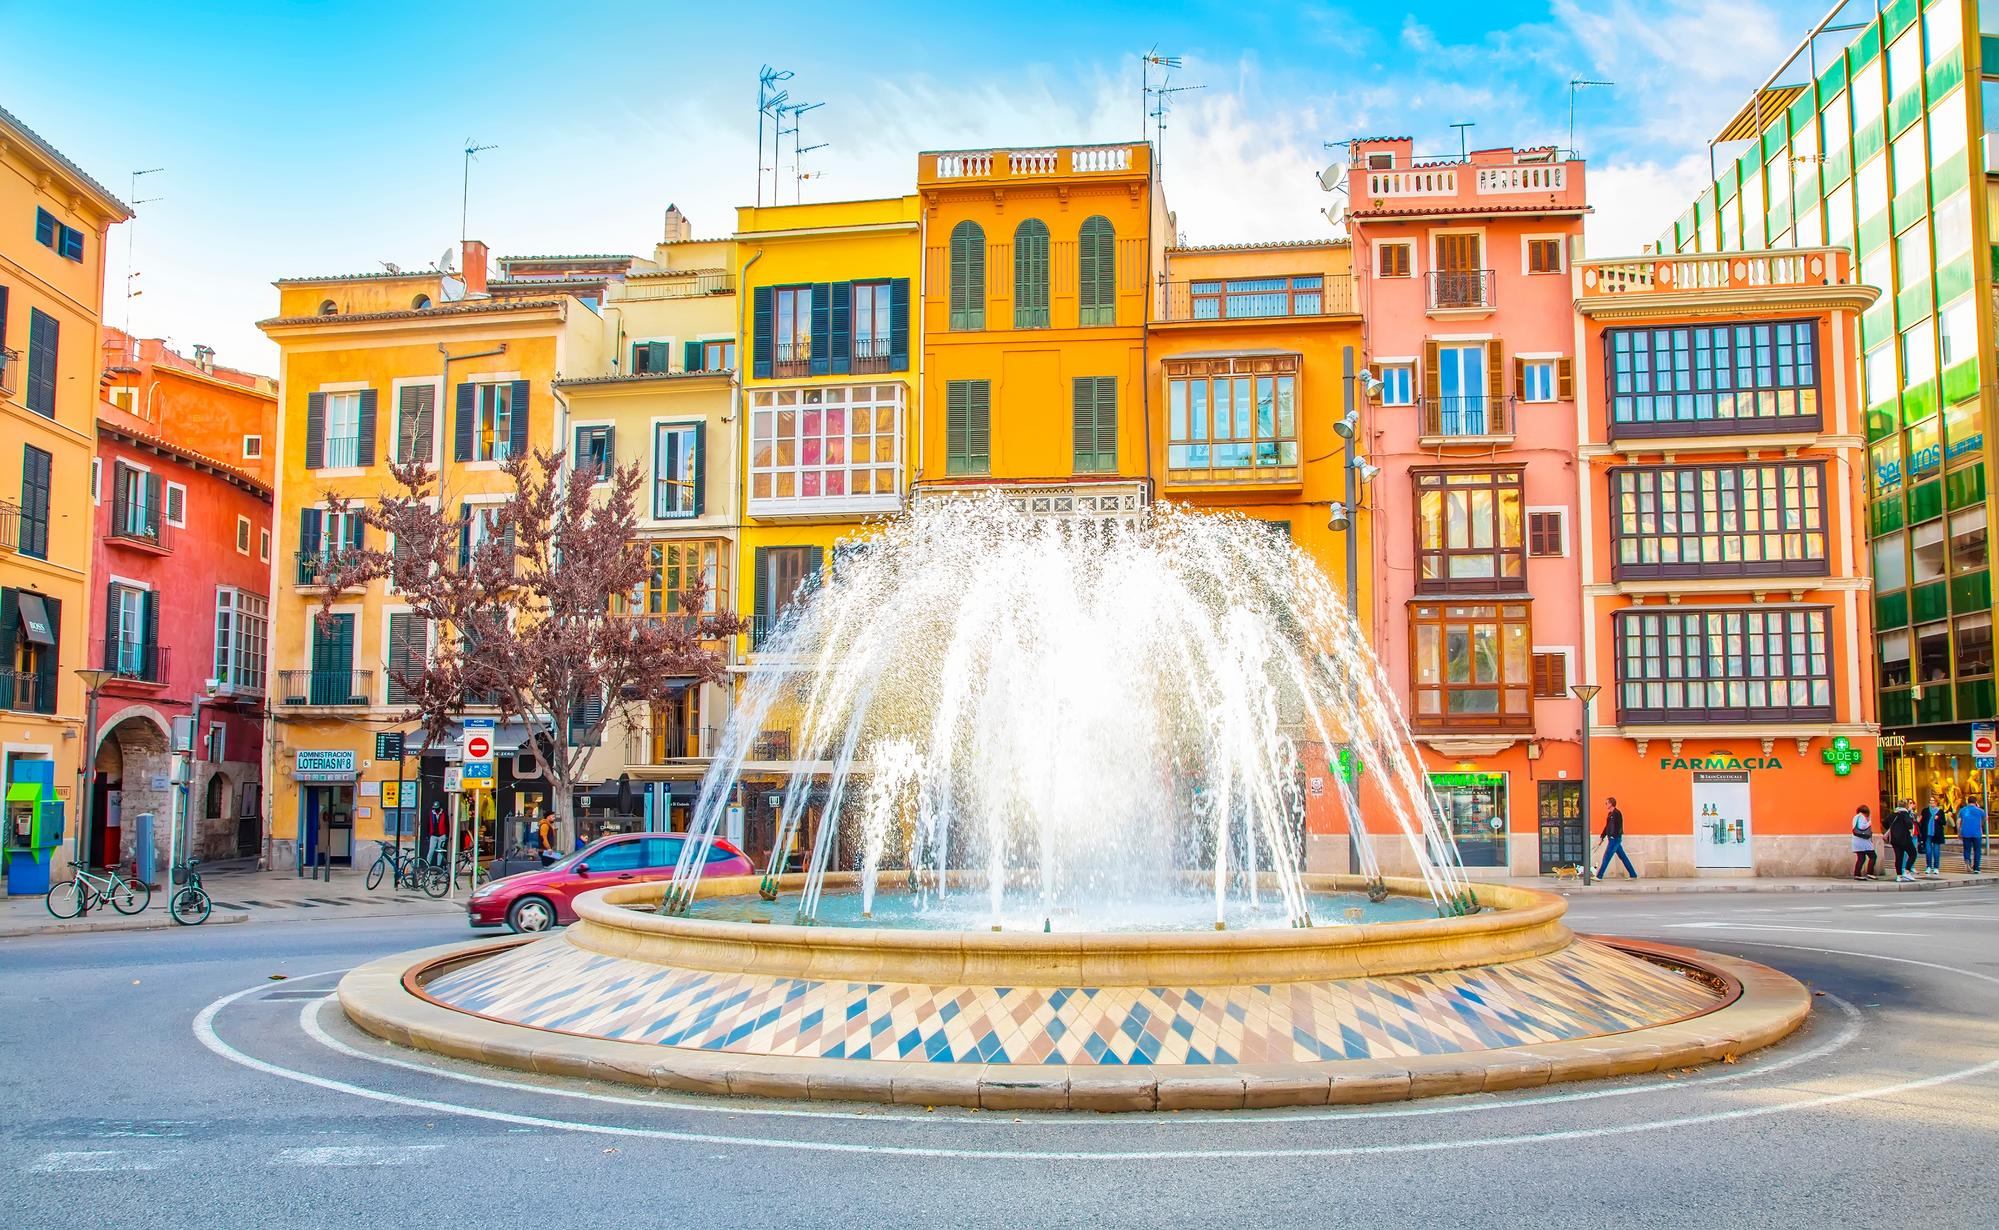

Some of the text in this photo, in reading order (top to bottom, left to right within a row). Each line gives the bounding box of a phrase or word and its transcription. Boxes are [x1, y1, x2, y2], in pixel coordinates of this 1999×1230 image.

[1837, 751, 1851, 760] DE
[1853, 751, 1859, 760] 9
[298, 759, 336, 770] LOTERIAS
[345, 759, 352, 770] 8
[1660, 758, 1783, 770] FARMACIA
